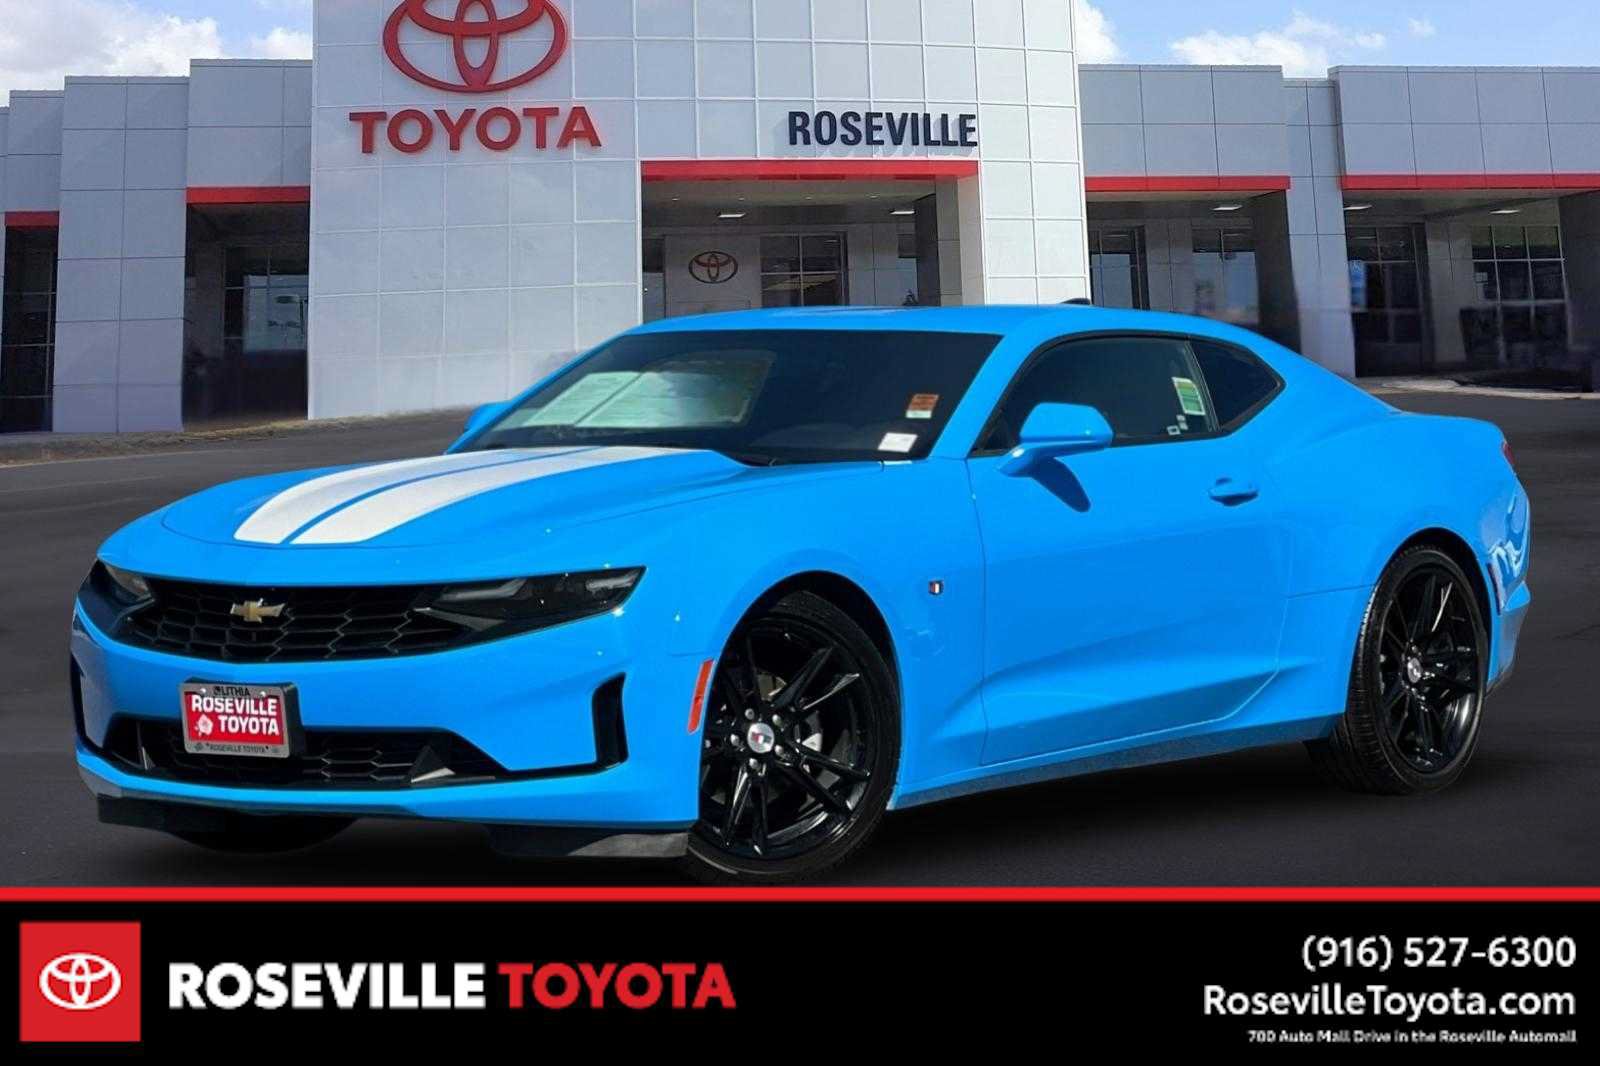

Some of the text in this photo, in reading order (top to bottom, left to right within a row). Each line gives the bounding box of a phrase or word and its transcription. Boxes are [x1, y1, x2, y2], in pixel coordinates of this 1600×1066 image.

[349, 106, 602, 153] TOYOTA
[788, 111, 978, 147] ROSEVILLE
[221, 686, 250, 695] LITHIA
[191, 694, 278, 716] ROSEVILLE
[218, 715, 280, 736] TOYOTA
